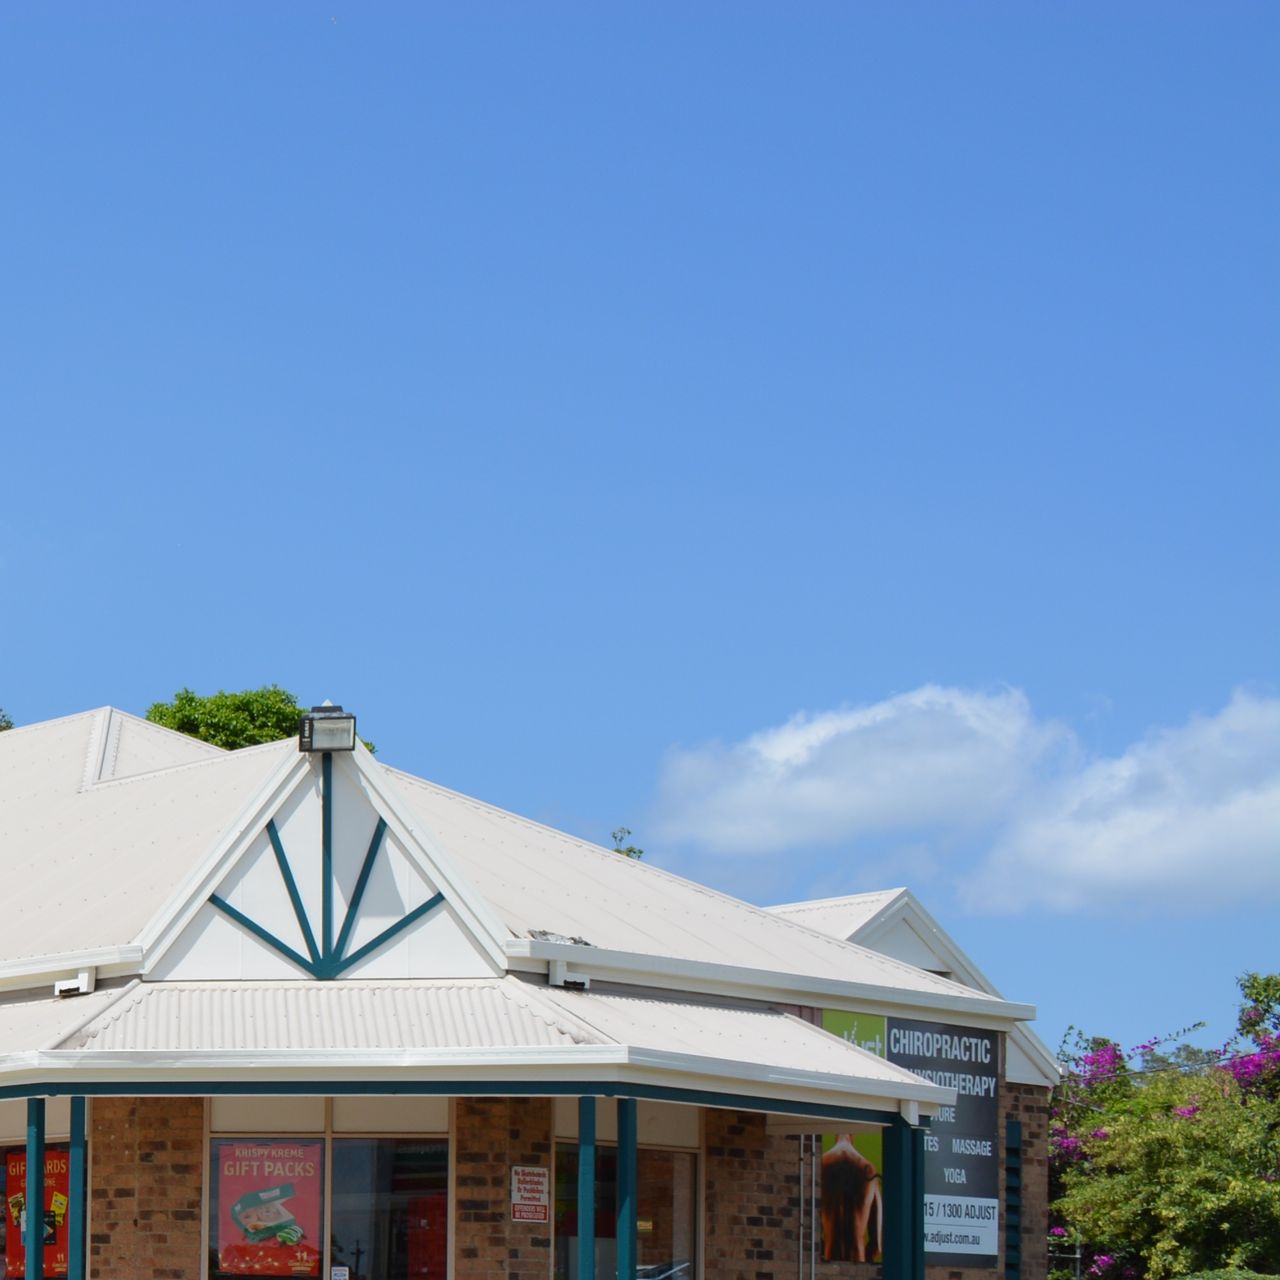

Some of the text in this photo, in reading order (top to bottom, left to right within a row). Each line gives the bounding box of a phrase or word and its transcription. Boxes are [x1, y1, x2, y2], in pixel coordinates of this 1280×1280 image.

[890, 1028, 991, 1063] CHIROPRACTIC
[235, 1148, 304, 1158] KRISPY KREME
[952, 1138, 992, 1156] MASSAGE
[9, 1162, 26, 1176] GIF
[224, 1161, 315, 1177] GIFT PACKS
[944, 1168, 966, 1184] YOGA
[942, 1204, 962, 1219] 1300
[964, 1205, 996, 1220] ADJUST
